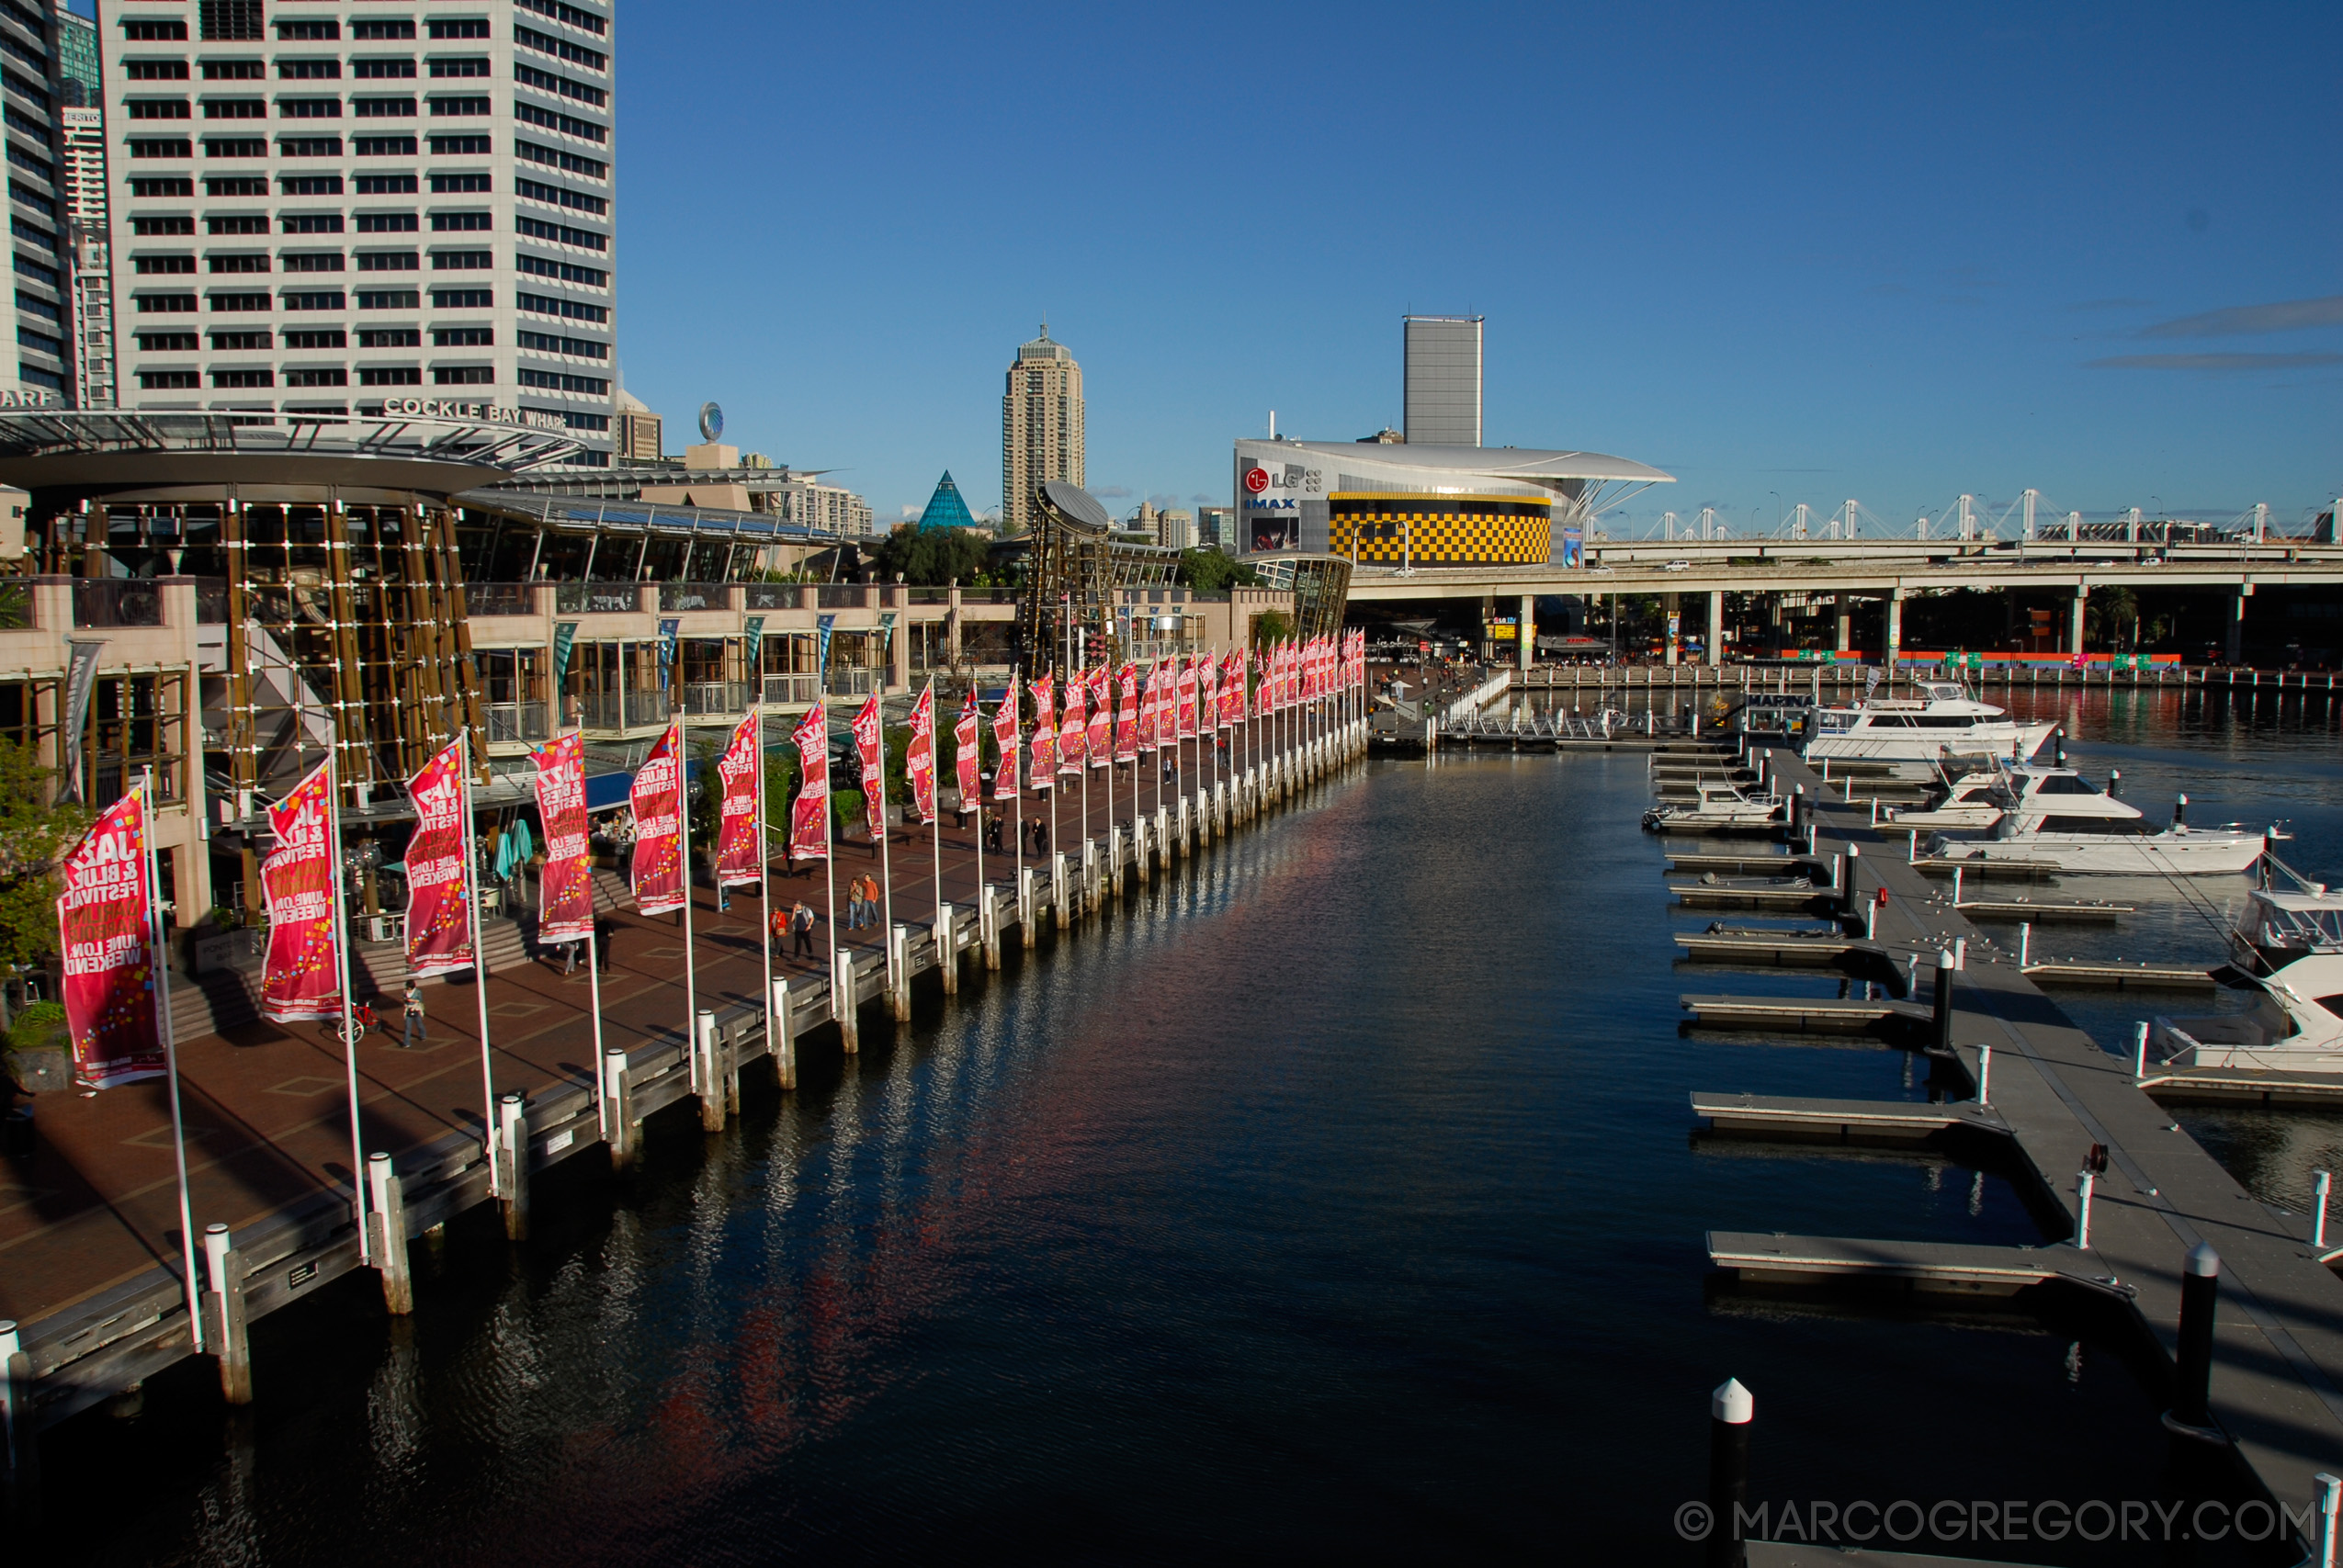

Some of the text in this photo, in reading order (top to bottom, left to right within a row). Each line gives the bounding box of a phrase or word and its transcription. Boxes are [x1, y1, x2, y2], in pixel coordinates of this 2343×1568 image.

[383, 398, 567, 433] COCKLE BAY WHARF
[1272, 473, 1299, 488] LG
[1245, 499, 1296, 510] IMAX
[1748, 694, 1817, 706] MARINA
